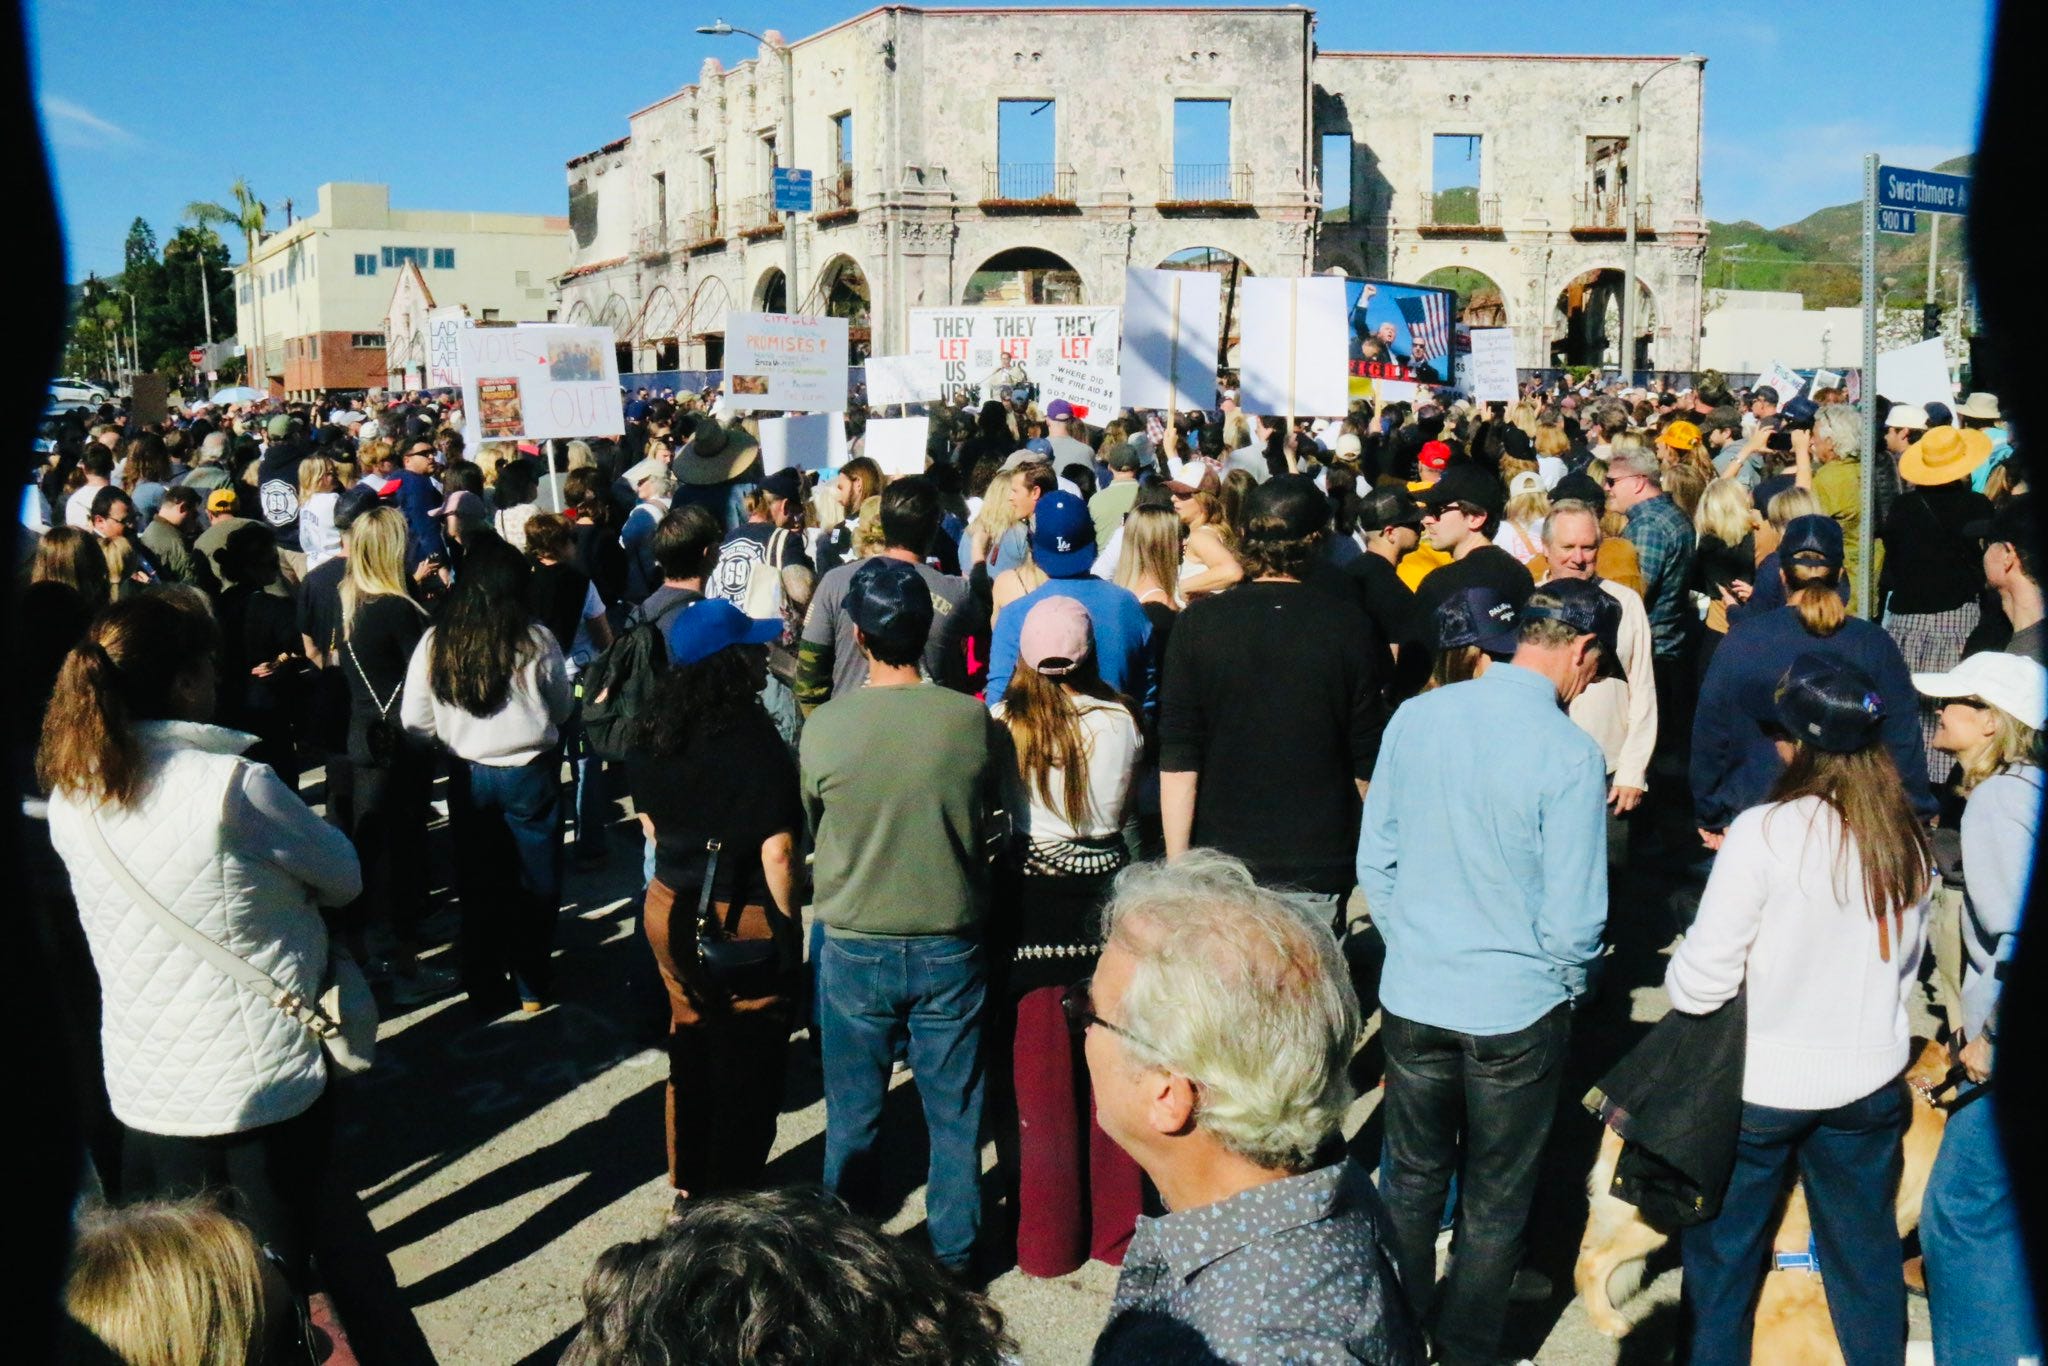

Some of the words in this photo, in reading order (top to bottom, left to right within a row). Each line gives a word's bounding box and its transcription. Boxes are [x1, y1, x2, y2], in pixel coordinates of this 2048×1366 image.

[1888, 174, 1955, 206] Swarthmore
[1882, 211, 1900, 229] 900
[1903, 213, 1910, 230] W
[933, 317, 975, 337] THEY
[993, 317, 1036, 337] THEY
[1055, 316, 1097, 336] THEY
[466, 333, 525, 363] VOTE
[746, 335, 815, 353] PROMISES
[939, 339, 970, 359] LET
[1000, 339, 1031, 359] LET
[1061, 338, 1092, 359] LET
[945, 361, 966, 381] US
[1058, 366, 1087, 380] WHERE
[1090, 376, 1104, 385] DID
[1050, 373, 1064, 383] THE
[1068, 380, 1086, 390] FIRE
[1088, 386, 1101, 394] AID
[1103, 389, 1113, 398] $$
[551, 386, 614, 429] OUT
[1047, 388, 1066, 398] GO?
[1068, 394, 1084, 403] NOT
[1086, 399, 1096, 407] TO
[1098, 403, 1113, 413] US!
[724, 561, 747, 586] 69
